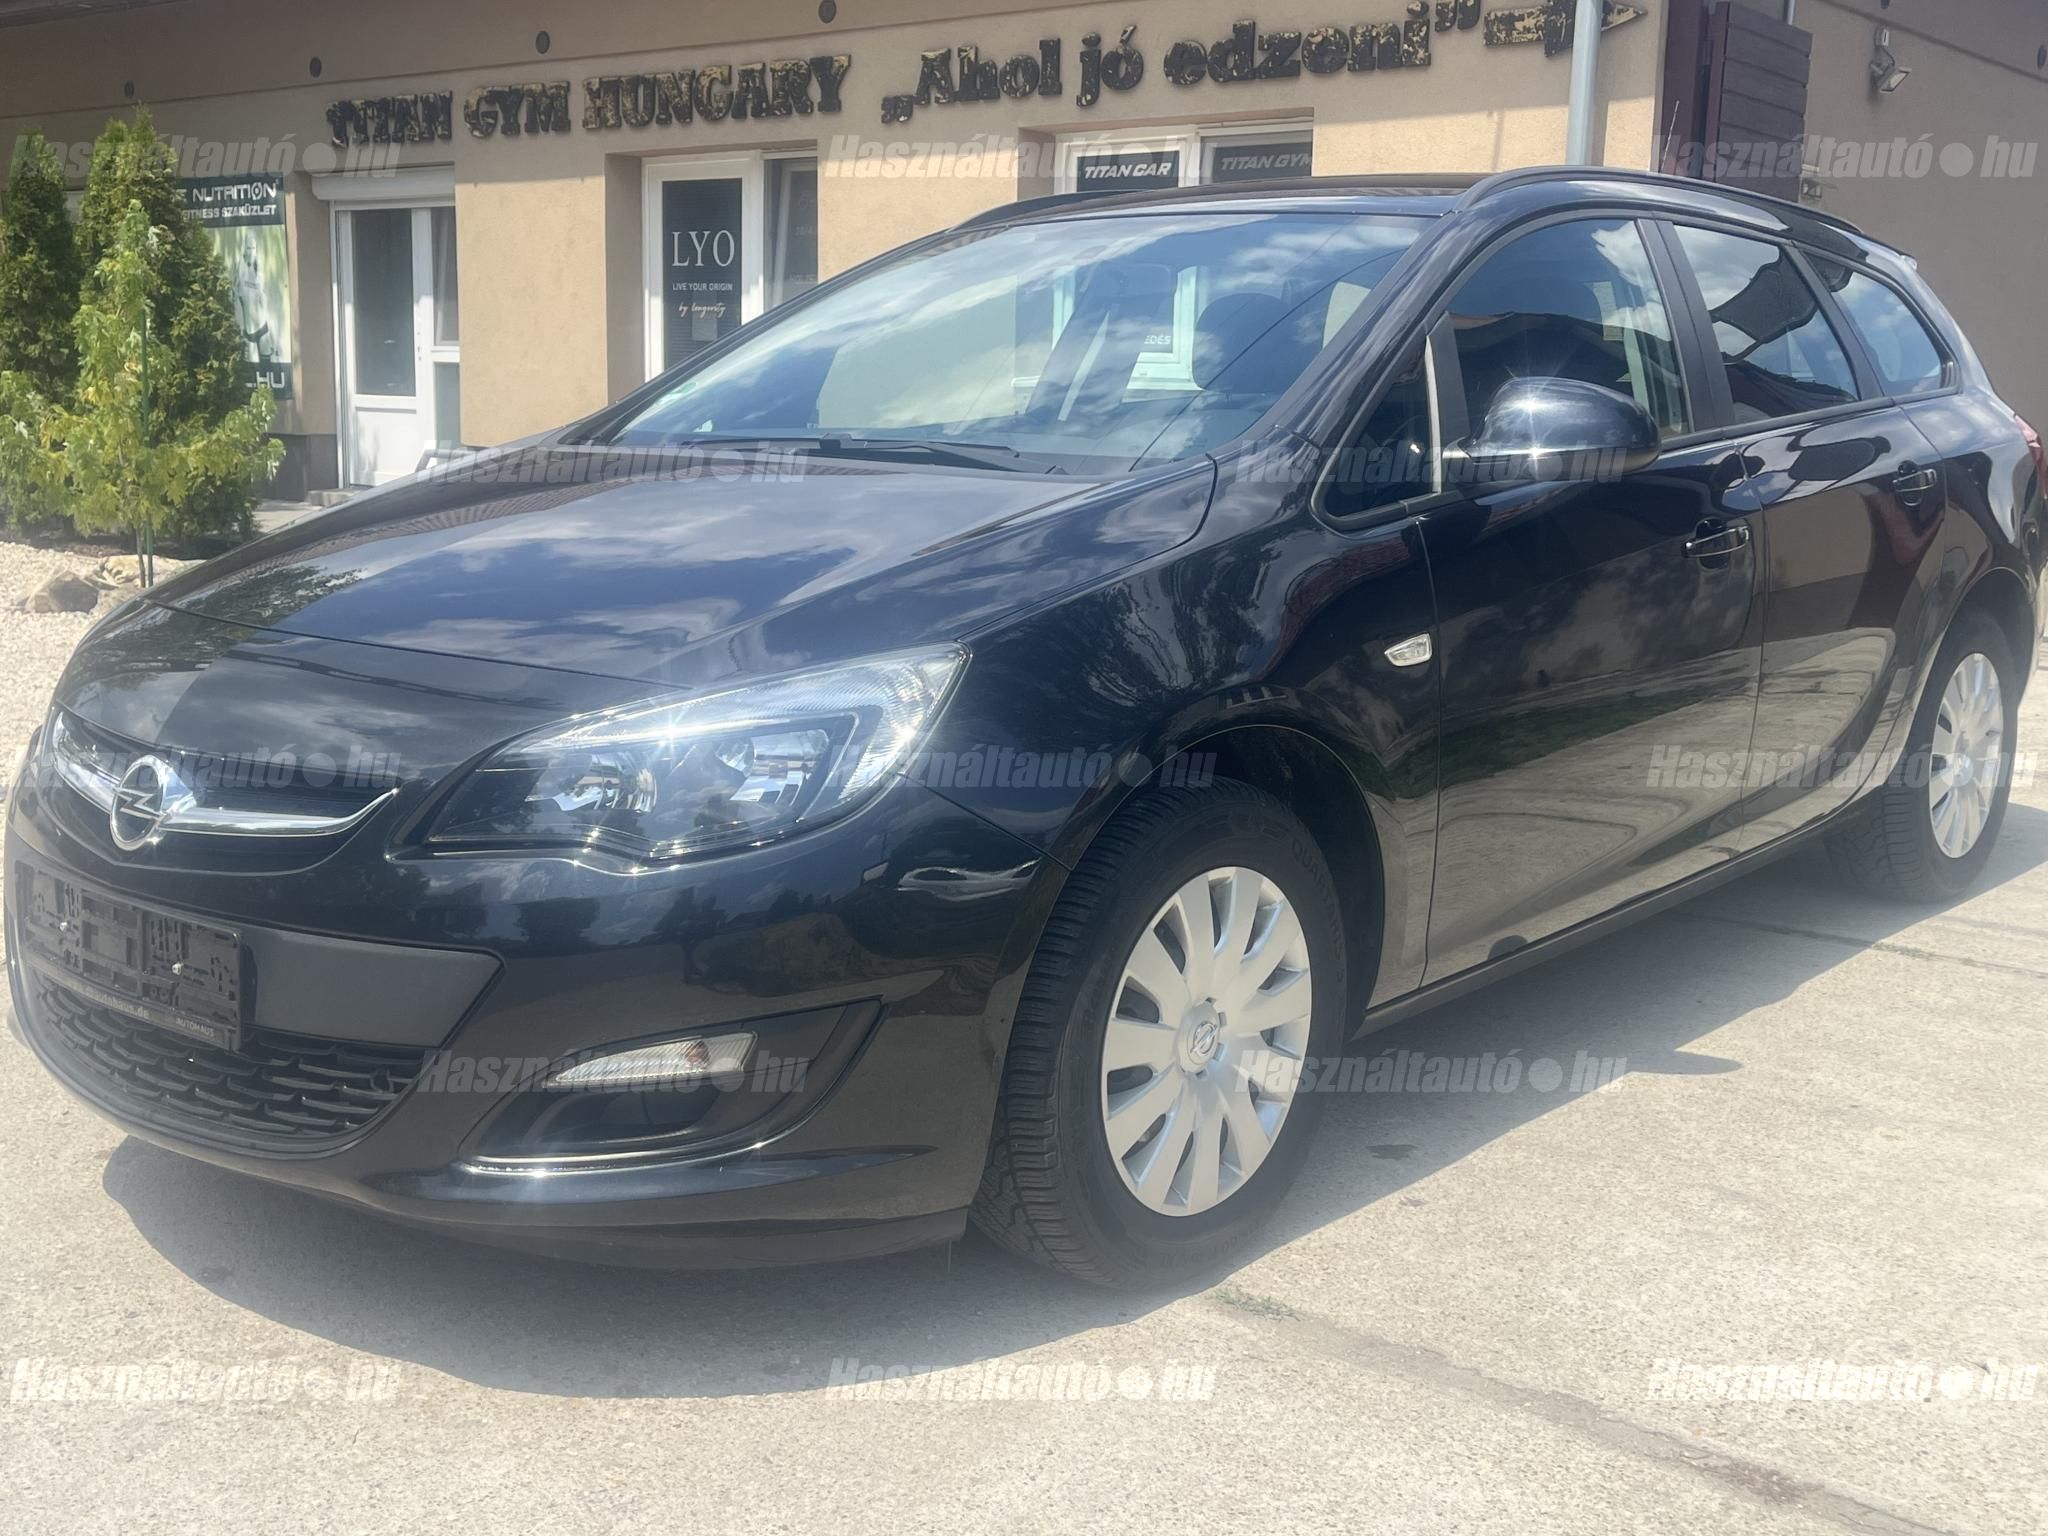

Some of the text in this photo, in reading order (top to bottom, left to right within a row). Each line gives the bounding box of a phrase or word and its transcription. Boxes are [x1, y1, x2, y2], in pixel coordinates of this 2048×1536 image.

[1076, 24, 1144, 107] jó
[326, 54, 851, 149] TITAN GYM HUNGARY
[1085, 162, 1172, 179] TITAN CAR
[1221, 155, 1274, 170] TITAN
[222, 203, 277, 218] SZAKÜZLET
[672, 230, 735, 267] LYO
[672, 282, 733, 291] LIVE YOUR ORIGIN
[679, 301, 689, 318] by
[176, 1017, 215, 1037] AUTOHAUS
